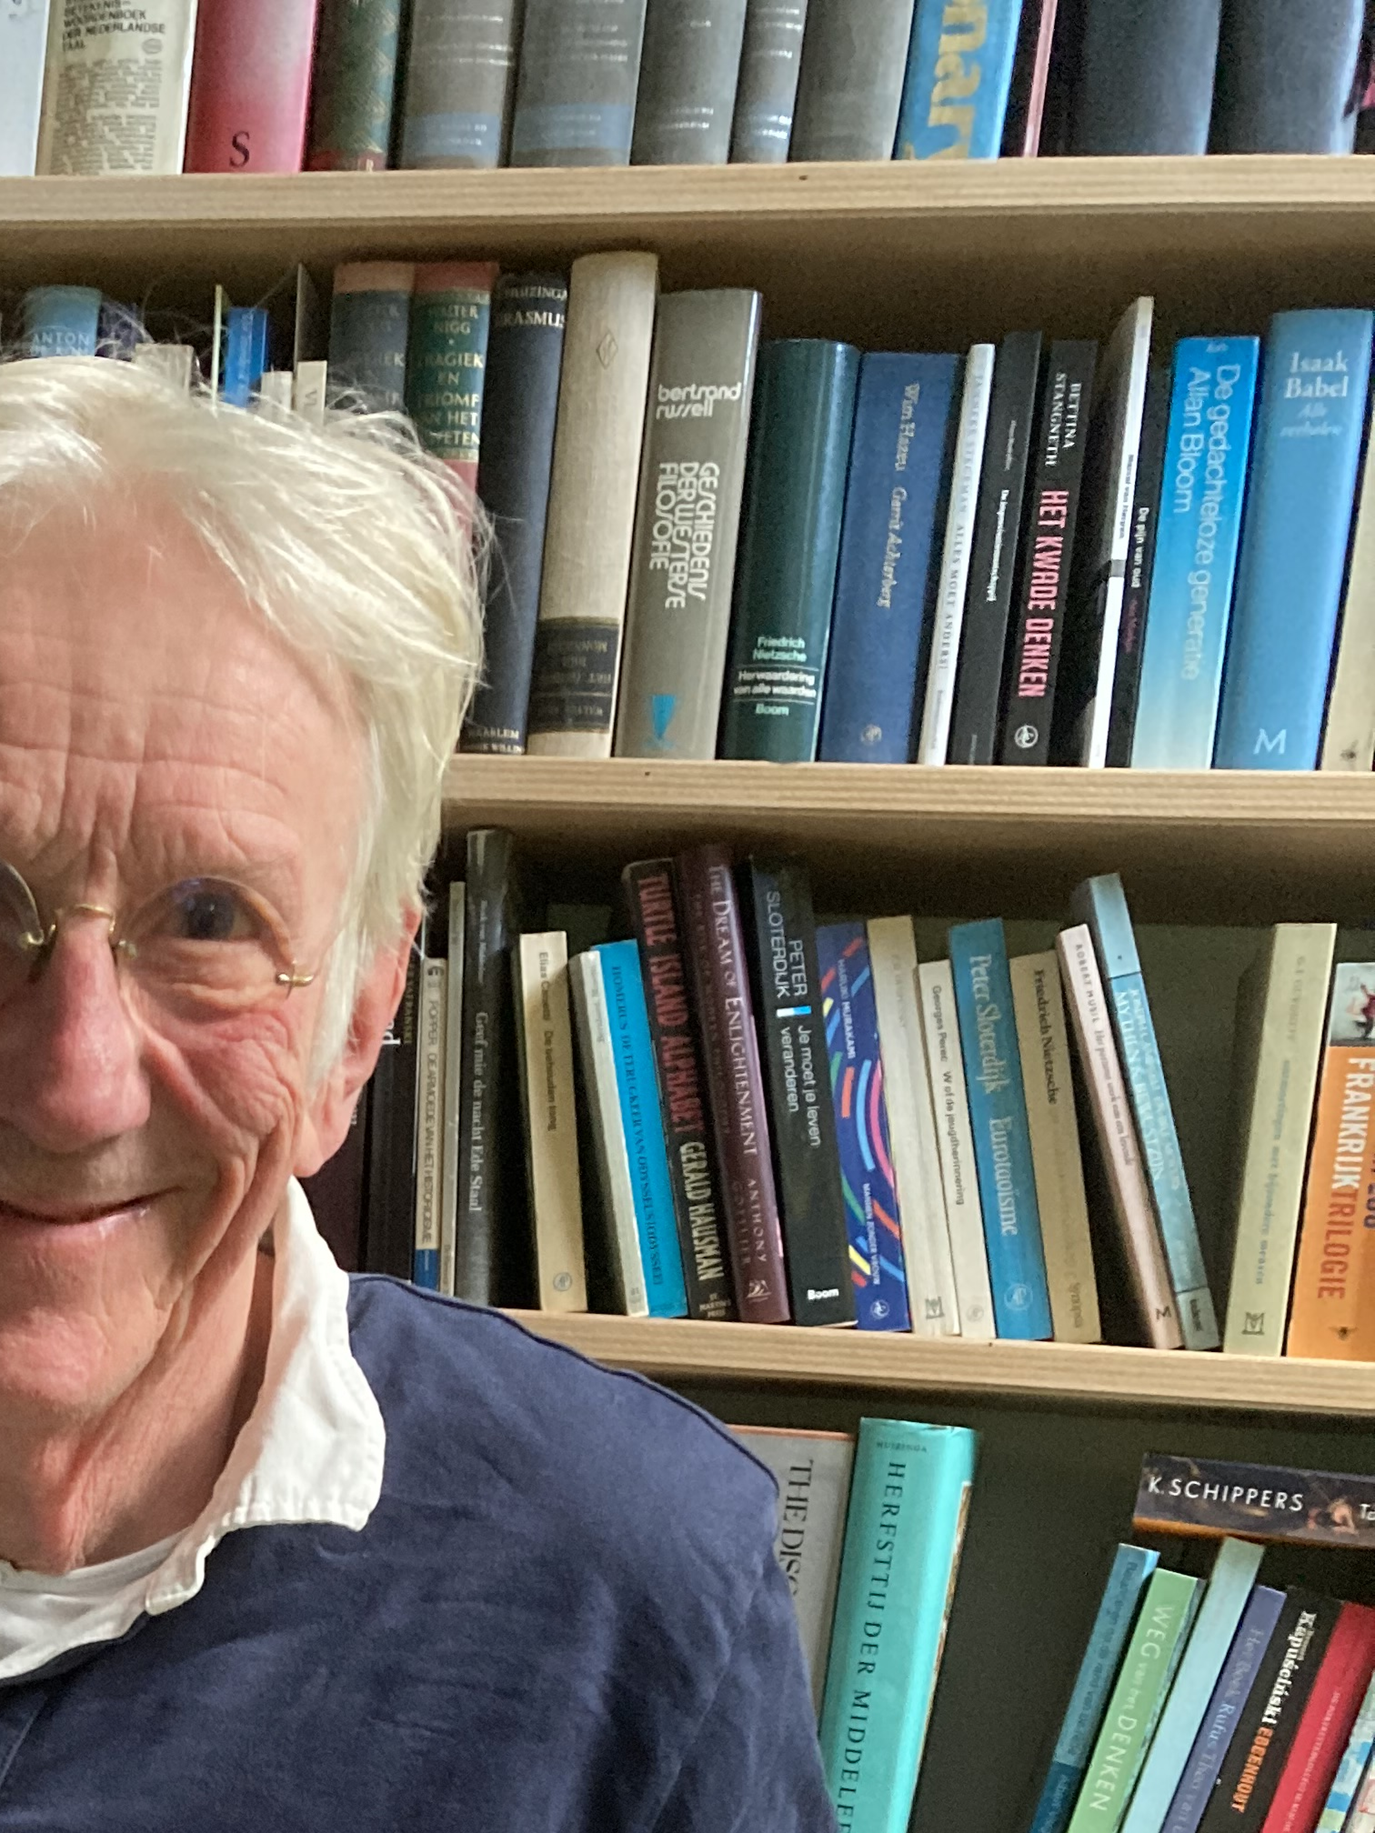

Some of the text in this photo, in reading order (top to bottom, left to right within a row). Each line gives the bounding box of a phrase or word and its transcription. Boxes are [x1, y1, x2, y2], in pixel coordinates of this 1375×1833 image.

[229, 131, 252, 168] S
[655, 404, 713, 419] russell
[656, 382, 742, 401] bertrand
[1044, 371, 1070, 466] STANGNETH
[1063, 382, 1083, 448] BETTINA
[1172, 366, 1211, 513] Allan Bloom
[648, 462, 679, 571] FILOSOFIE
[664, 462, 697, 609] DER WESTERSE
[687, 463, 721, 601] GESCHIEDENIS
[876, 382, 921, 611] Wim Hazeu Gerrit Achterberg
[1180, 363, 1241, 680] De gedachteloze generatie
[1017, 489, 1070, 698] HET KWADE DENKEN
[637, 872, 671, 945] TURTLE
[765, 889, 792, 998] SLOTERDIJK
[538, 952, 553, 980] Elias
[648, 954, 684, 1027] ISLAND
[787, 939, 809, 996] PETER
[836, 958, 858, 1059] HARUKI MURAKAMI
[543, 1029, 556, 1045] De
[660, 1034, 705, 1133] ALPHABET
[779, 1026, 803, 1112] veranderen
[796, 1024, 824, 1146] Je moet je leven
[1032, 969, 1061, 1106] Friedrich Nietzsche
[967, 953, 1021, 1236] Peter Sloterdijk Eurotaoïsme
[679, 1140, 713, 1200] GERALD
[690, 1201, 726, 1280] HAUSMAN
[782, 1457, 815, 1523] THE
[1147, 1475, 1305, 1515] K. SCHIPPERS
[856, 1461, 908, 1676] HERFSTTIJ DER
[1141, 1604, 1177, 1658] WEG
[1231, 1610, 1317, 1813] Kapuściński EBBENHOUT
[1088, 1715, 1139, 1812] DENKEN
